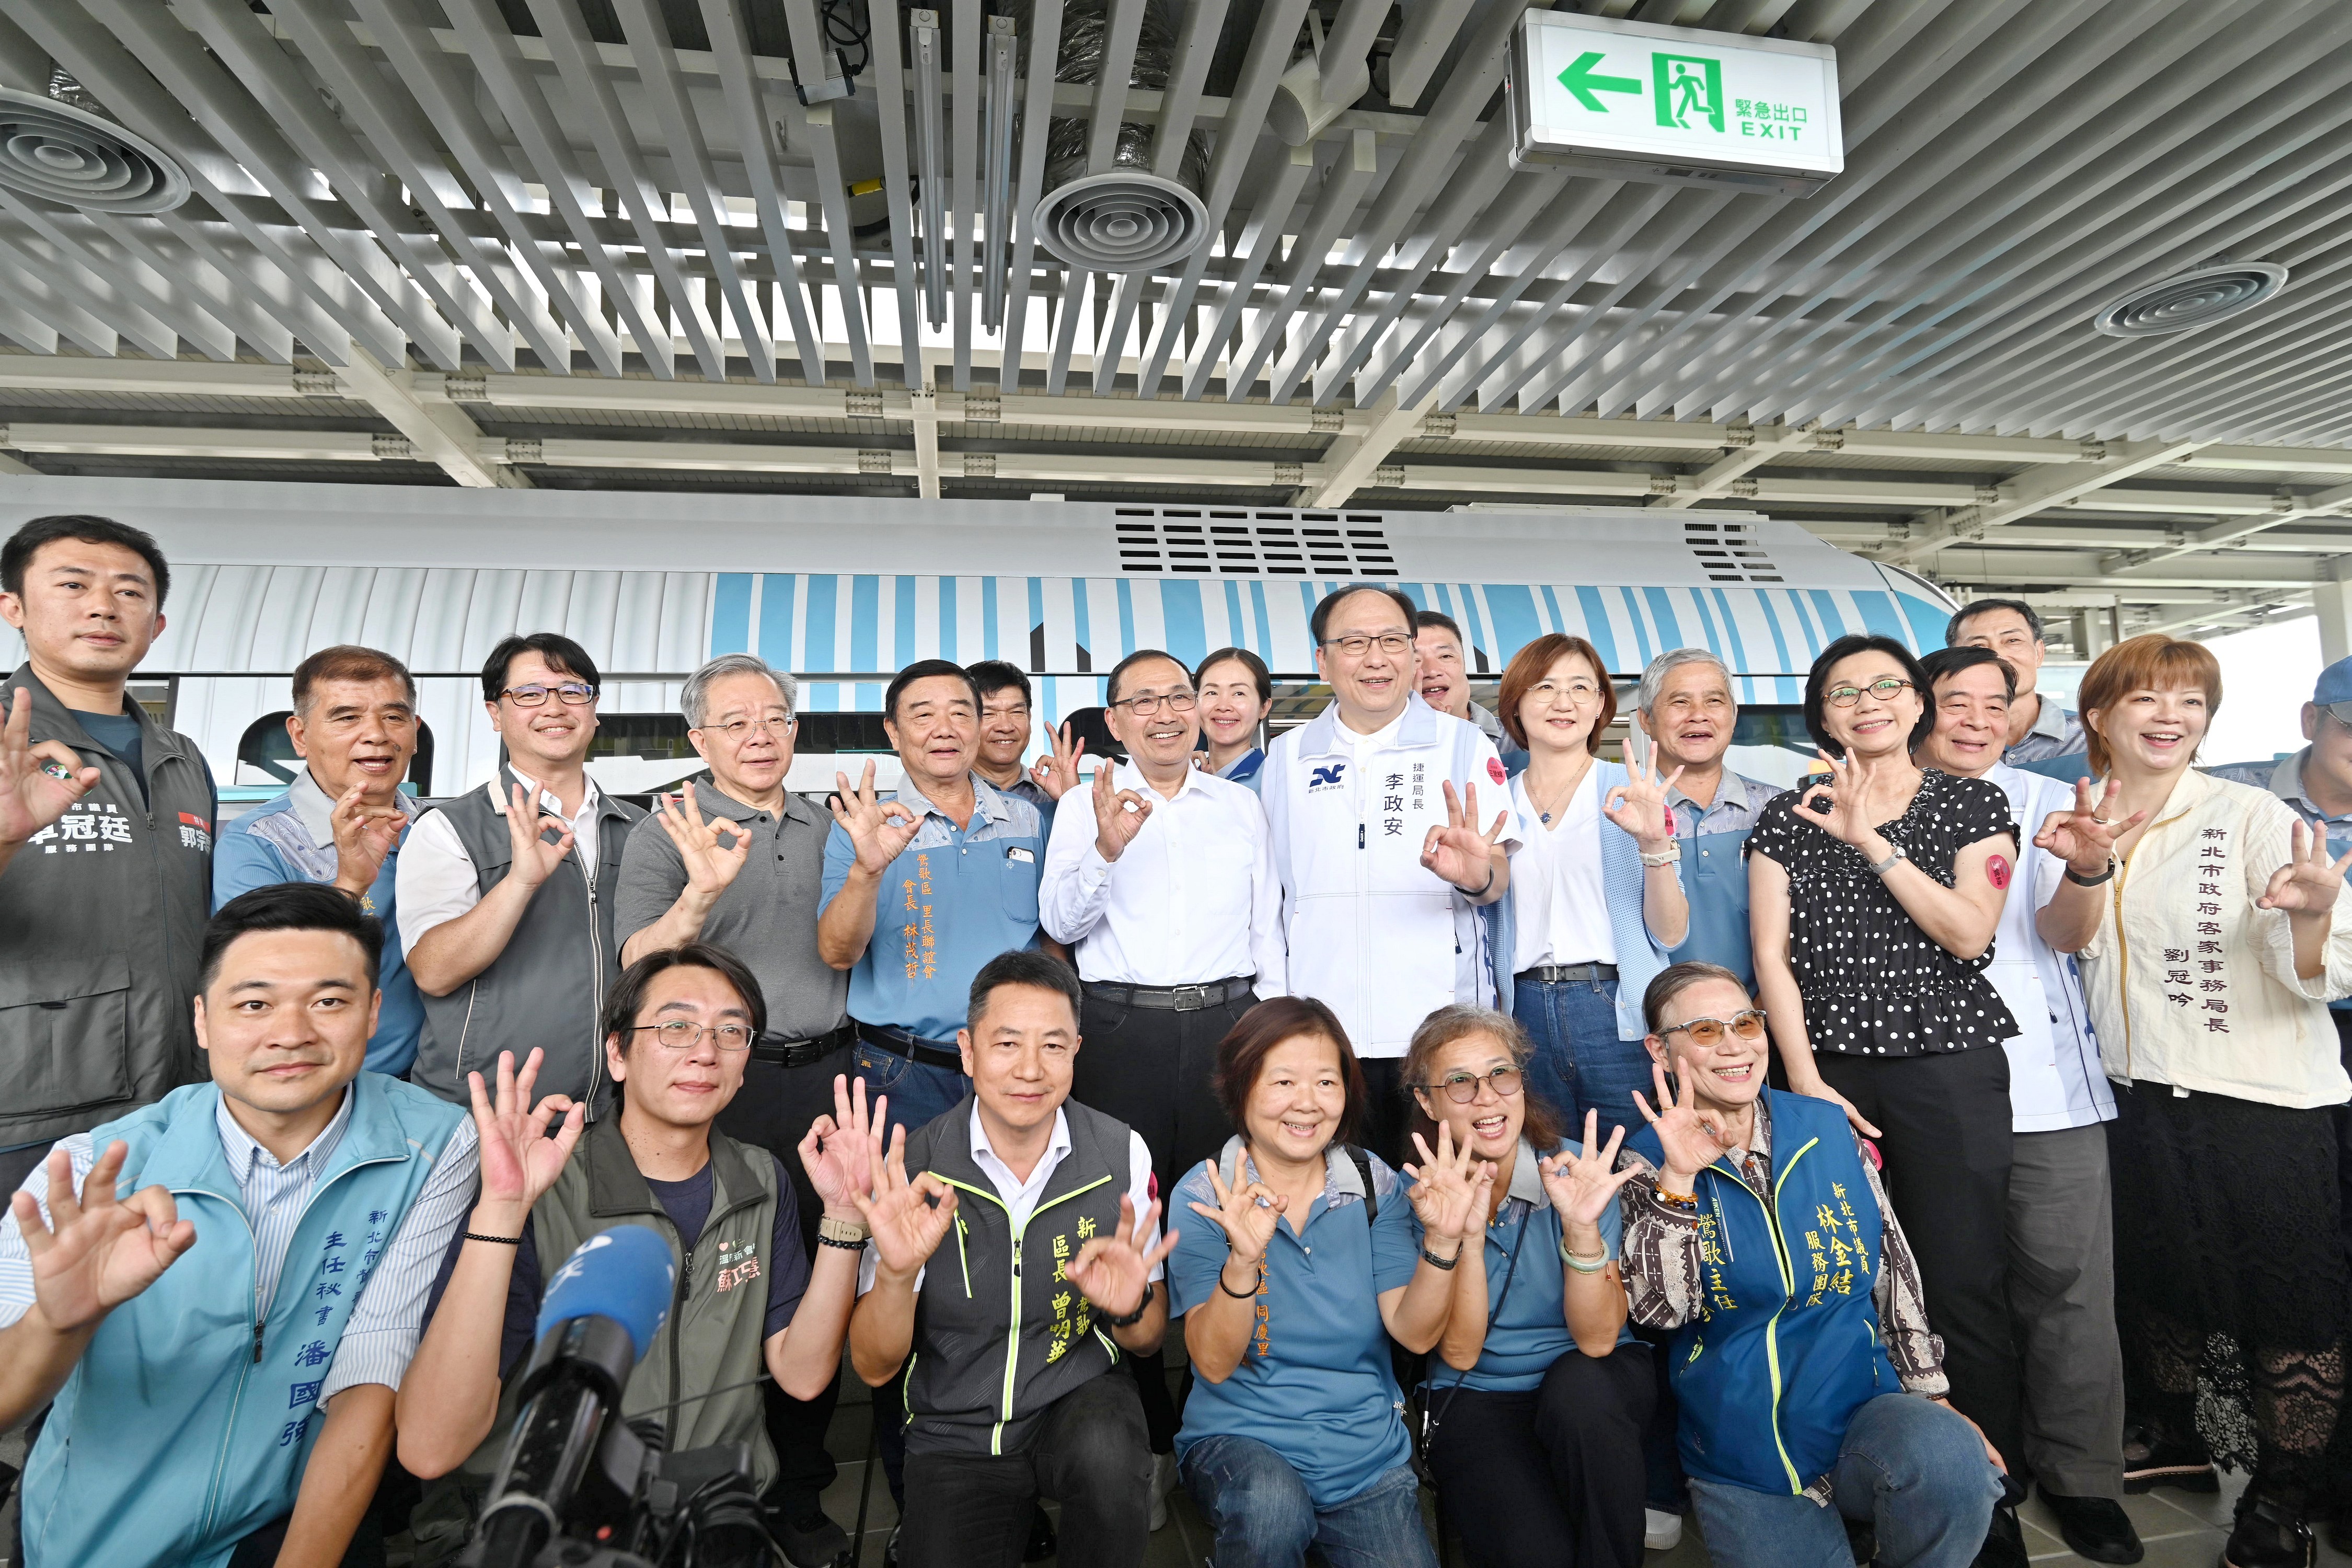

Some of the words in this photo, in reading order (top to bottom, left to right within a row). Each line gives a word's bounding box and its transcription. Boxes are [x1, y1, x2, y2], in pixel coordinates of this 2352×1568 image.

[1735, 98, 1807, 123] 緊急出口
[1741, 121, 1802, 141] EXIT
[1308, 784, 1344, 794] 新北市政府
[1383, 773, 1404, 836] 李政安
[1412, 763, 1424, 810] 捷運局長
[902, 879, 919, 911] 會長
[917, 854, 933, 895] 鶯歌區
[903, 923, 919, 988] 林茂哲
[921, 905, 937, 979] 里長聯誼會
[2197, 828, 2230, 1033] 新北市政府客家事務局長
[2164, 949, 2194, 1008] 劉冠吟
[1712, 1197, 1721, 1217] AIKEN
[1832, 1182, 1871, 1275] 新北市議員
[1052, 1234, 1070, 1283] 區長
[1805, 1230, 1829, 1307] 服務團隊
[1816, 1204, 1854, 1295] 林金結
[316, 1231, 348, 1326] 主任秘書
[1255, 1305, 1271, 1356] 同慶里
